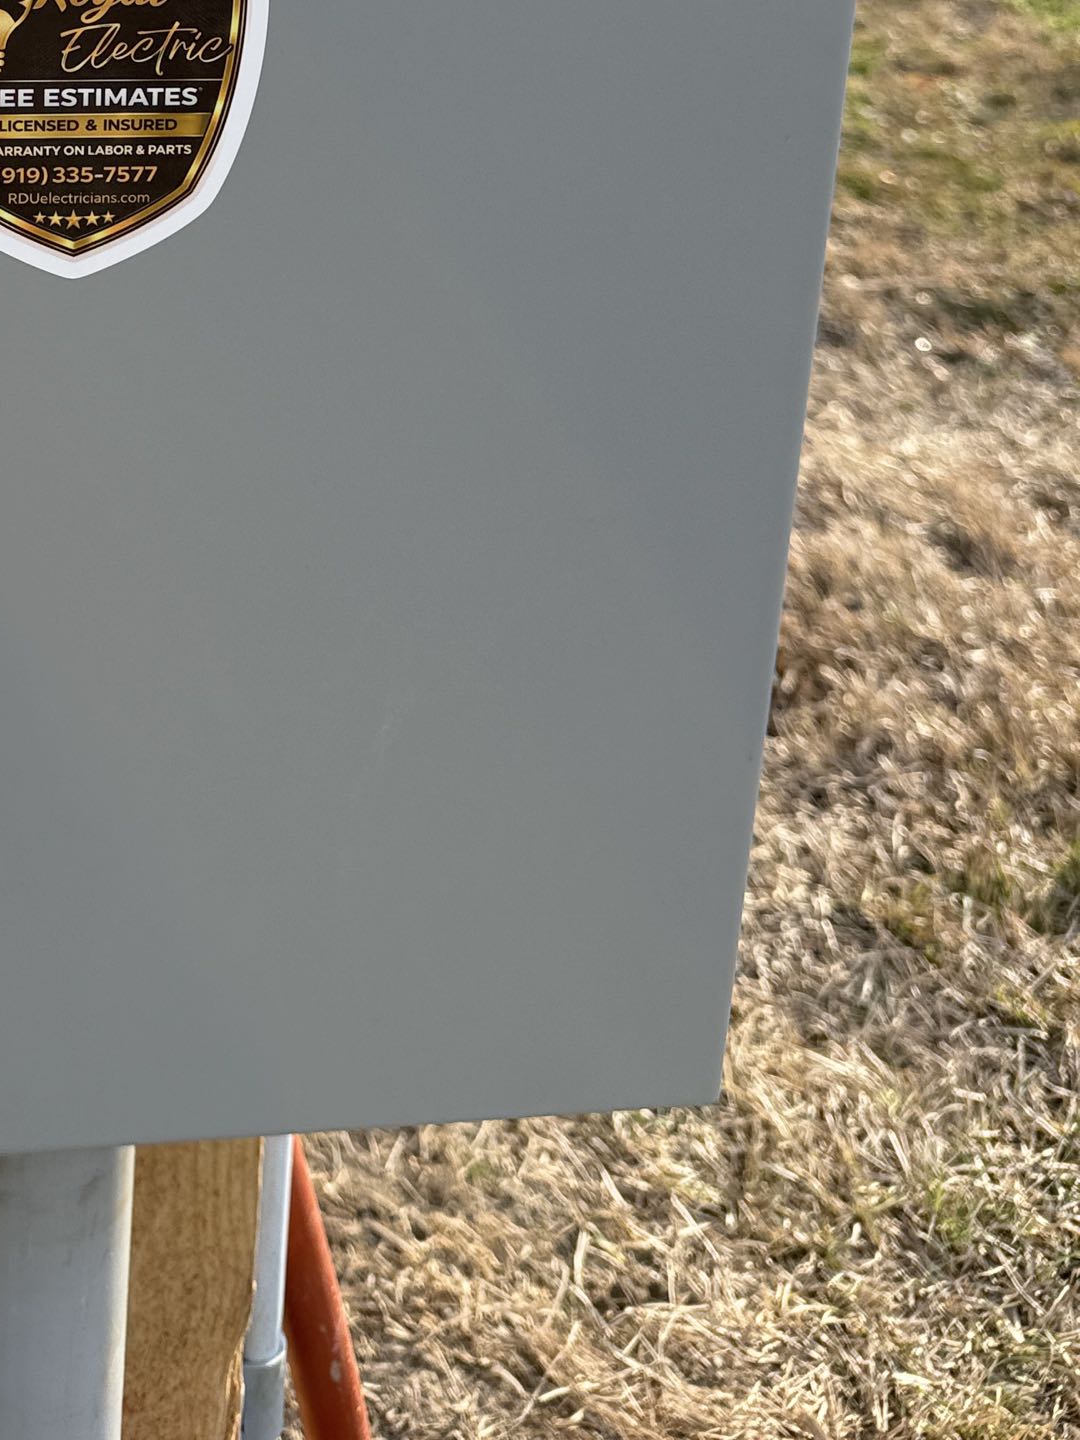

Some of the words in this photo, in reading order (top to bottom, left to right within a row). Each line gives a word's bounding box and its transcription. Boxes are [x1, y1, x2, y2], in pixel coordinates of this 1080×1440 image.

[60, 21, 232, 76] Electric
[43, 87, 198, 107] ESTIMATES
[85, 119, 98, 131] &
[103, 118, 178, 131] INSURED
[63, 145, 85, 156] ON
[88, 145, 133, 156] LABOR
[135, 145, 145, 155] &
[148, 144, 192, 155] PARTS
[52, 165, 158, 183] 335-7577
[8, 192, 150, 205] RDUelectricians.com
